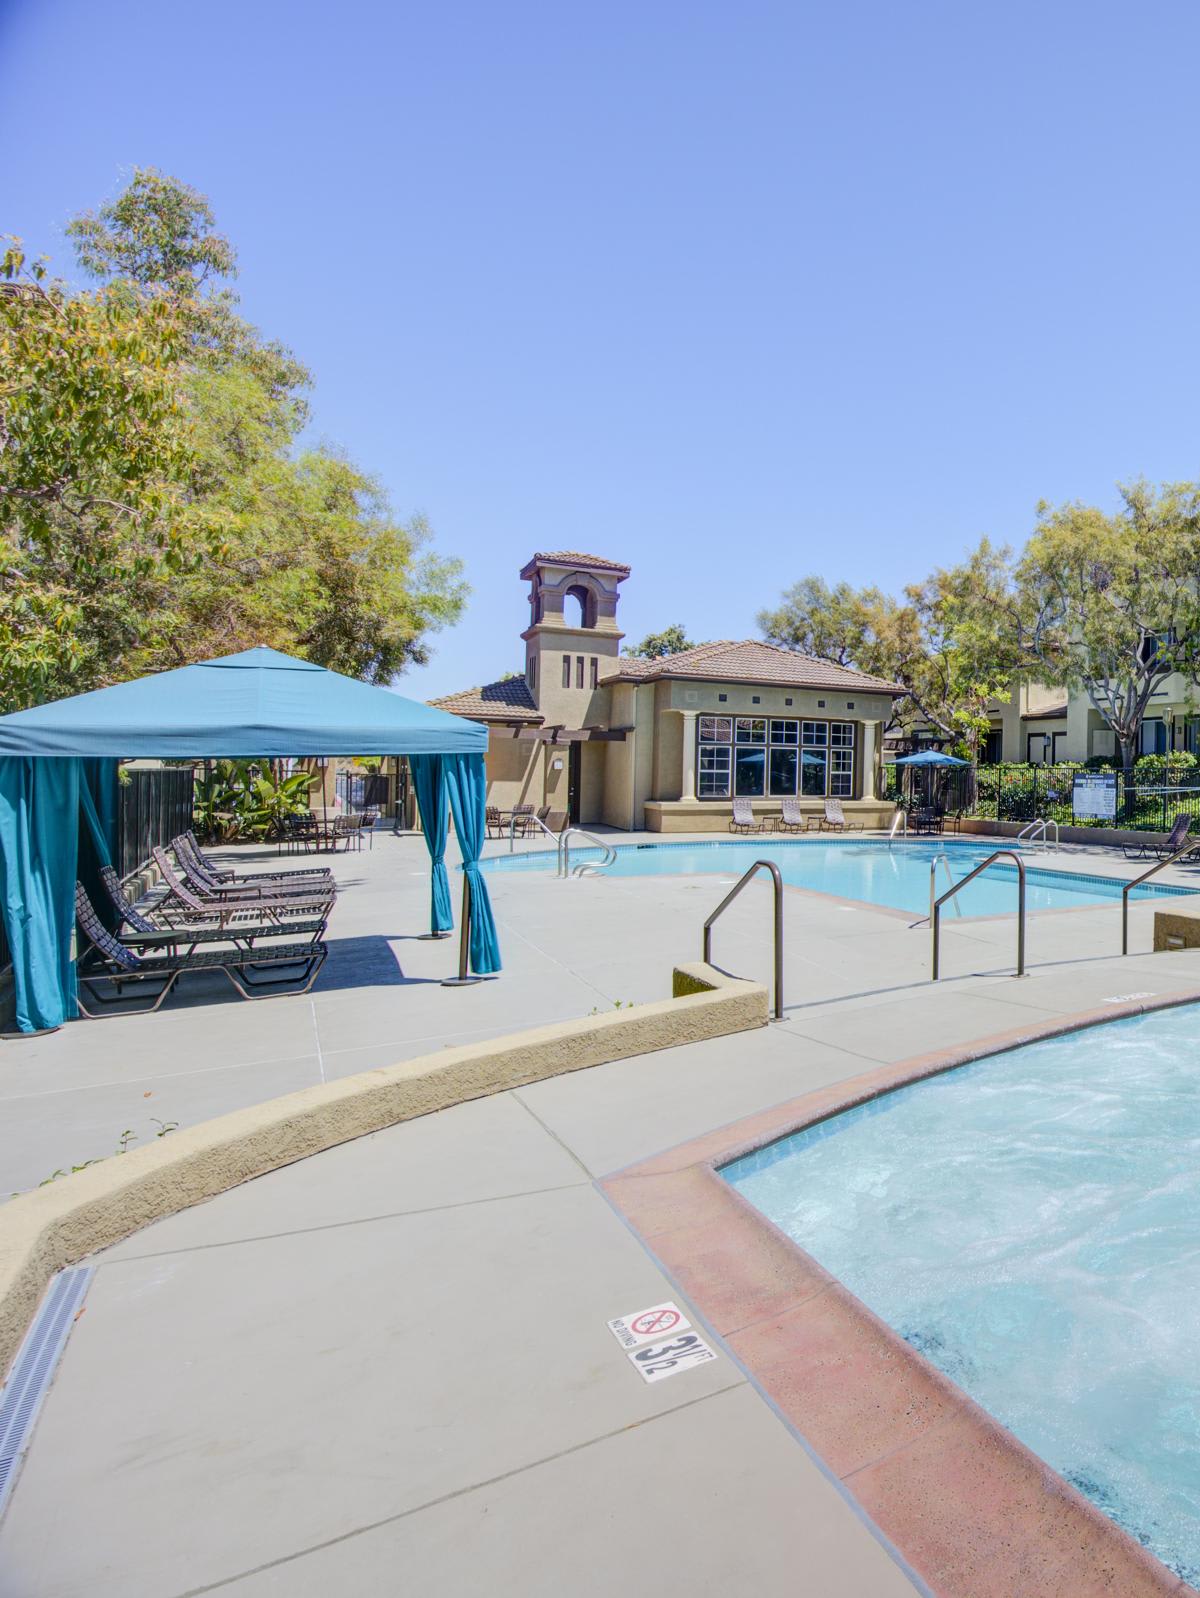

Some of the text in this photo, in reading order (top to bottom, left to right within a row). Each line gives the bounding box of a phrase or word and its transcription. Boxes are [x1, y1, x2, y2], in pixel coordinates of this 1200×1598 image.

[611, 1319, 638, 1346] NO DIVING
[694, 1351, 713, 1362] FT
